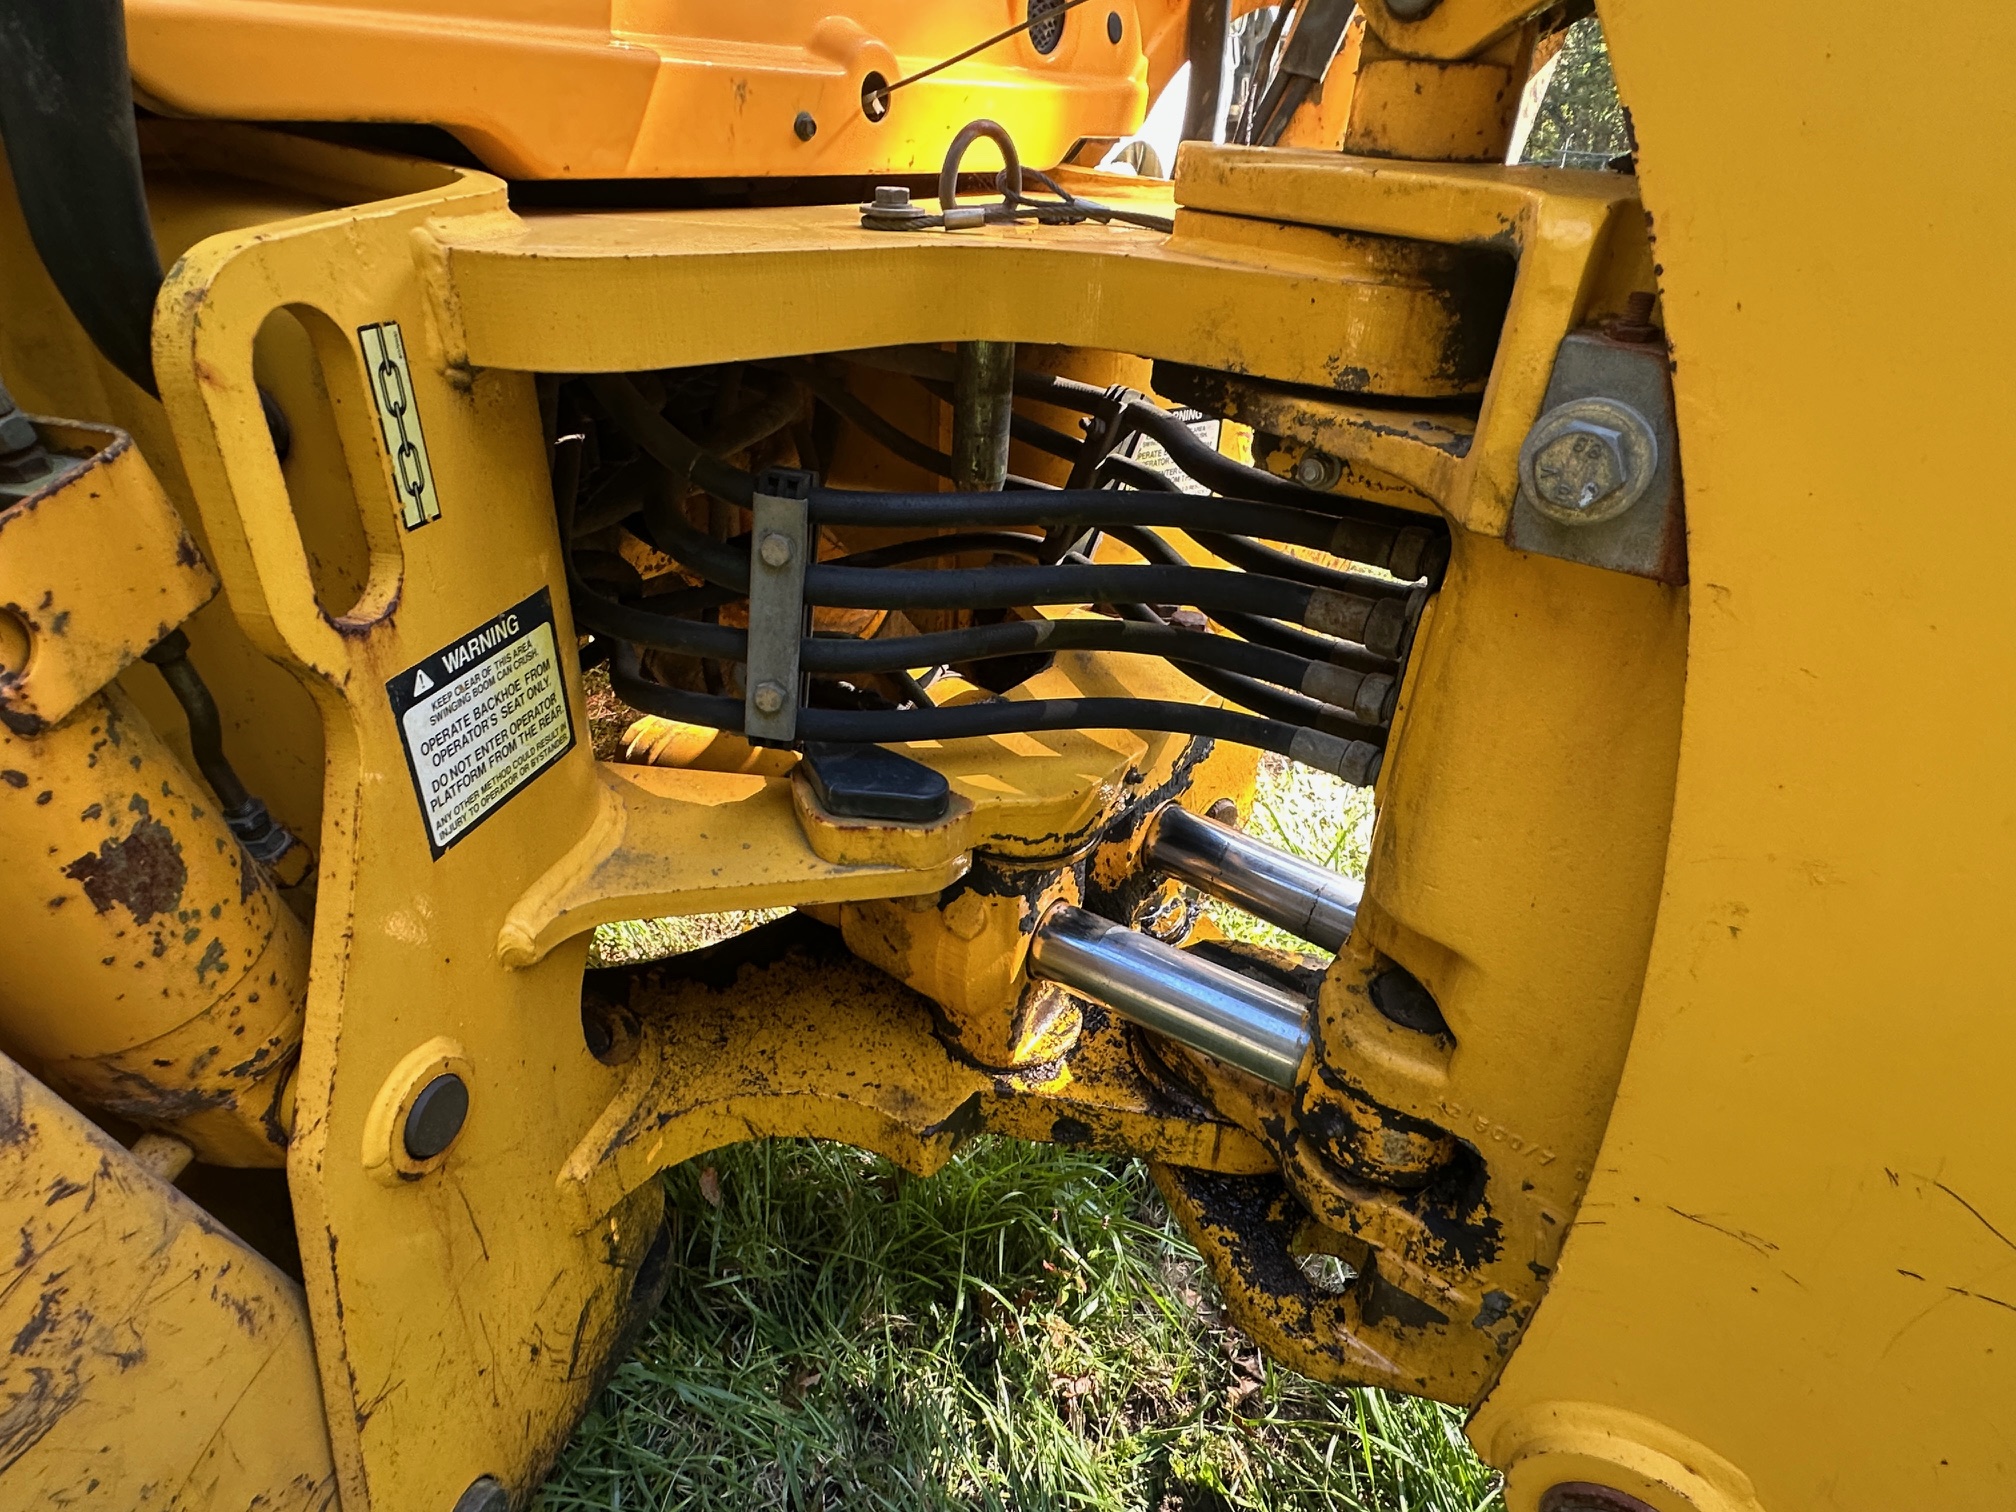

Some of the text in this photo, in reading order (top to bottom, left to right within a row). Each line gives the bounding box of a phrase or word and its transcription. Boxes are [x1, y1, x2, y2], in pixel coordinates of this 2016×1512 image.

[431, 691, 453, 712] KEEP
[481, 665, 492, 679] OF
[494, 653, 511, 670] THIS
[513, 639, 533, 659] AREA
[441, 614, 519, 674] WARNING
[420, 658, 551, 756] OPERATE BACKHOE FROM
[429, 692, 472, 726] SWINGING
[472, 675, 496, 698] BOOM
[497, 664, 513, 681] CAN
[432, 675, 552, 767] OPERATOR'S SEAT ONLY.
[430, 704, 564, 813] PLATFORM FROM THE REAR.
[431, 692, 557, 794] DO NOT ENTER OPERATOR
[436, 811, 453, 831] ANY
[453, 790, 480, 816] OTHER
[480, 765, 512, 795] METHOD
[512, 746, 536, 770] COULD
[536, 727, 559, 752] RESULT
[438, 812, 467, 841] INJURY
[468, 803, 480, 816] TO
[480, 772, 519, 807] OPERATOR
[519, 763, 531, 776] OR
